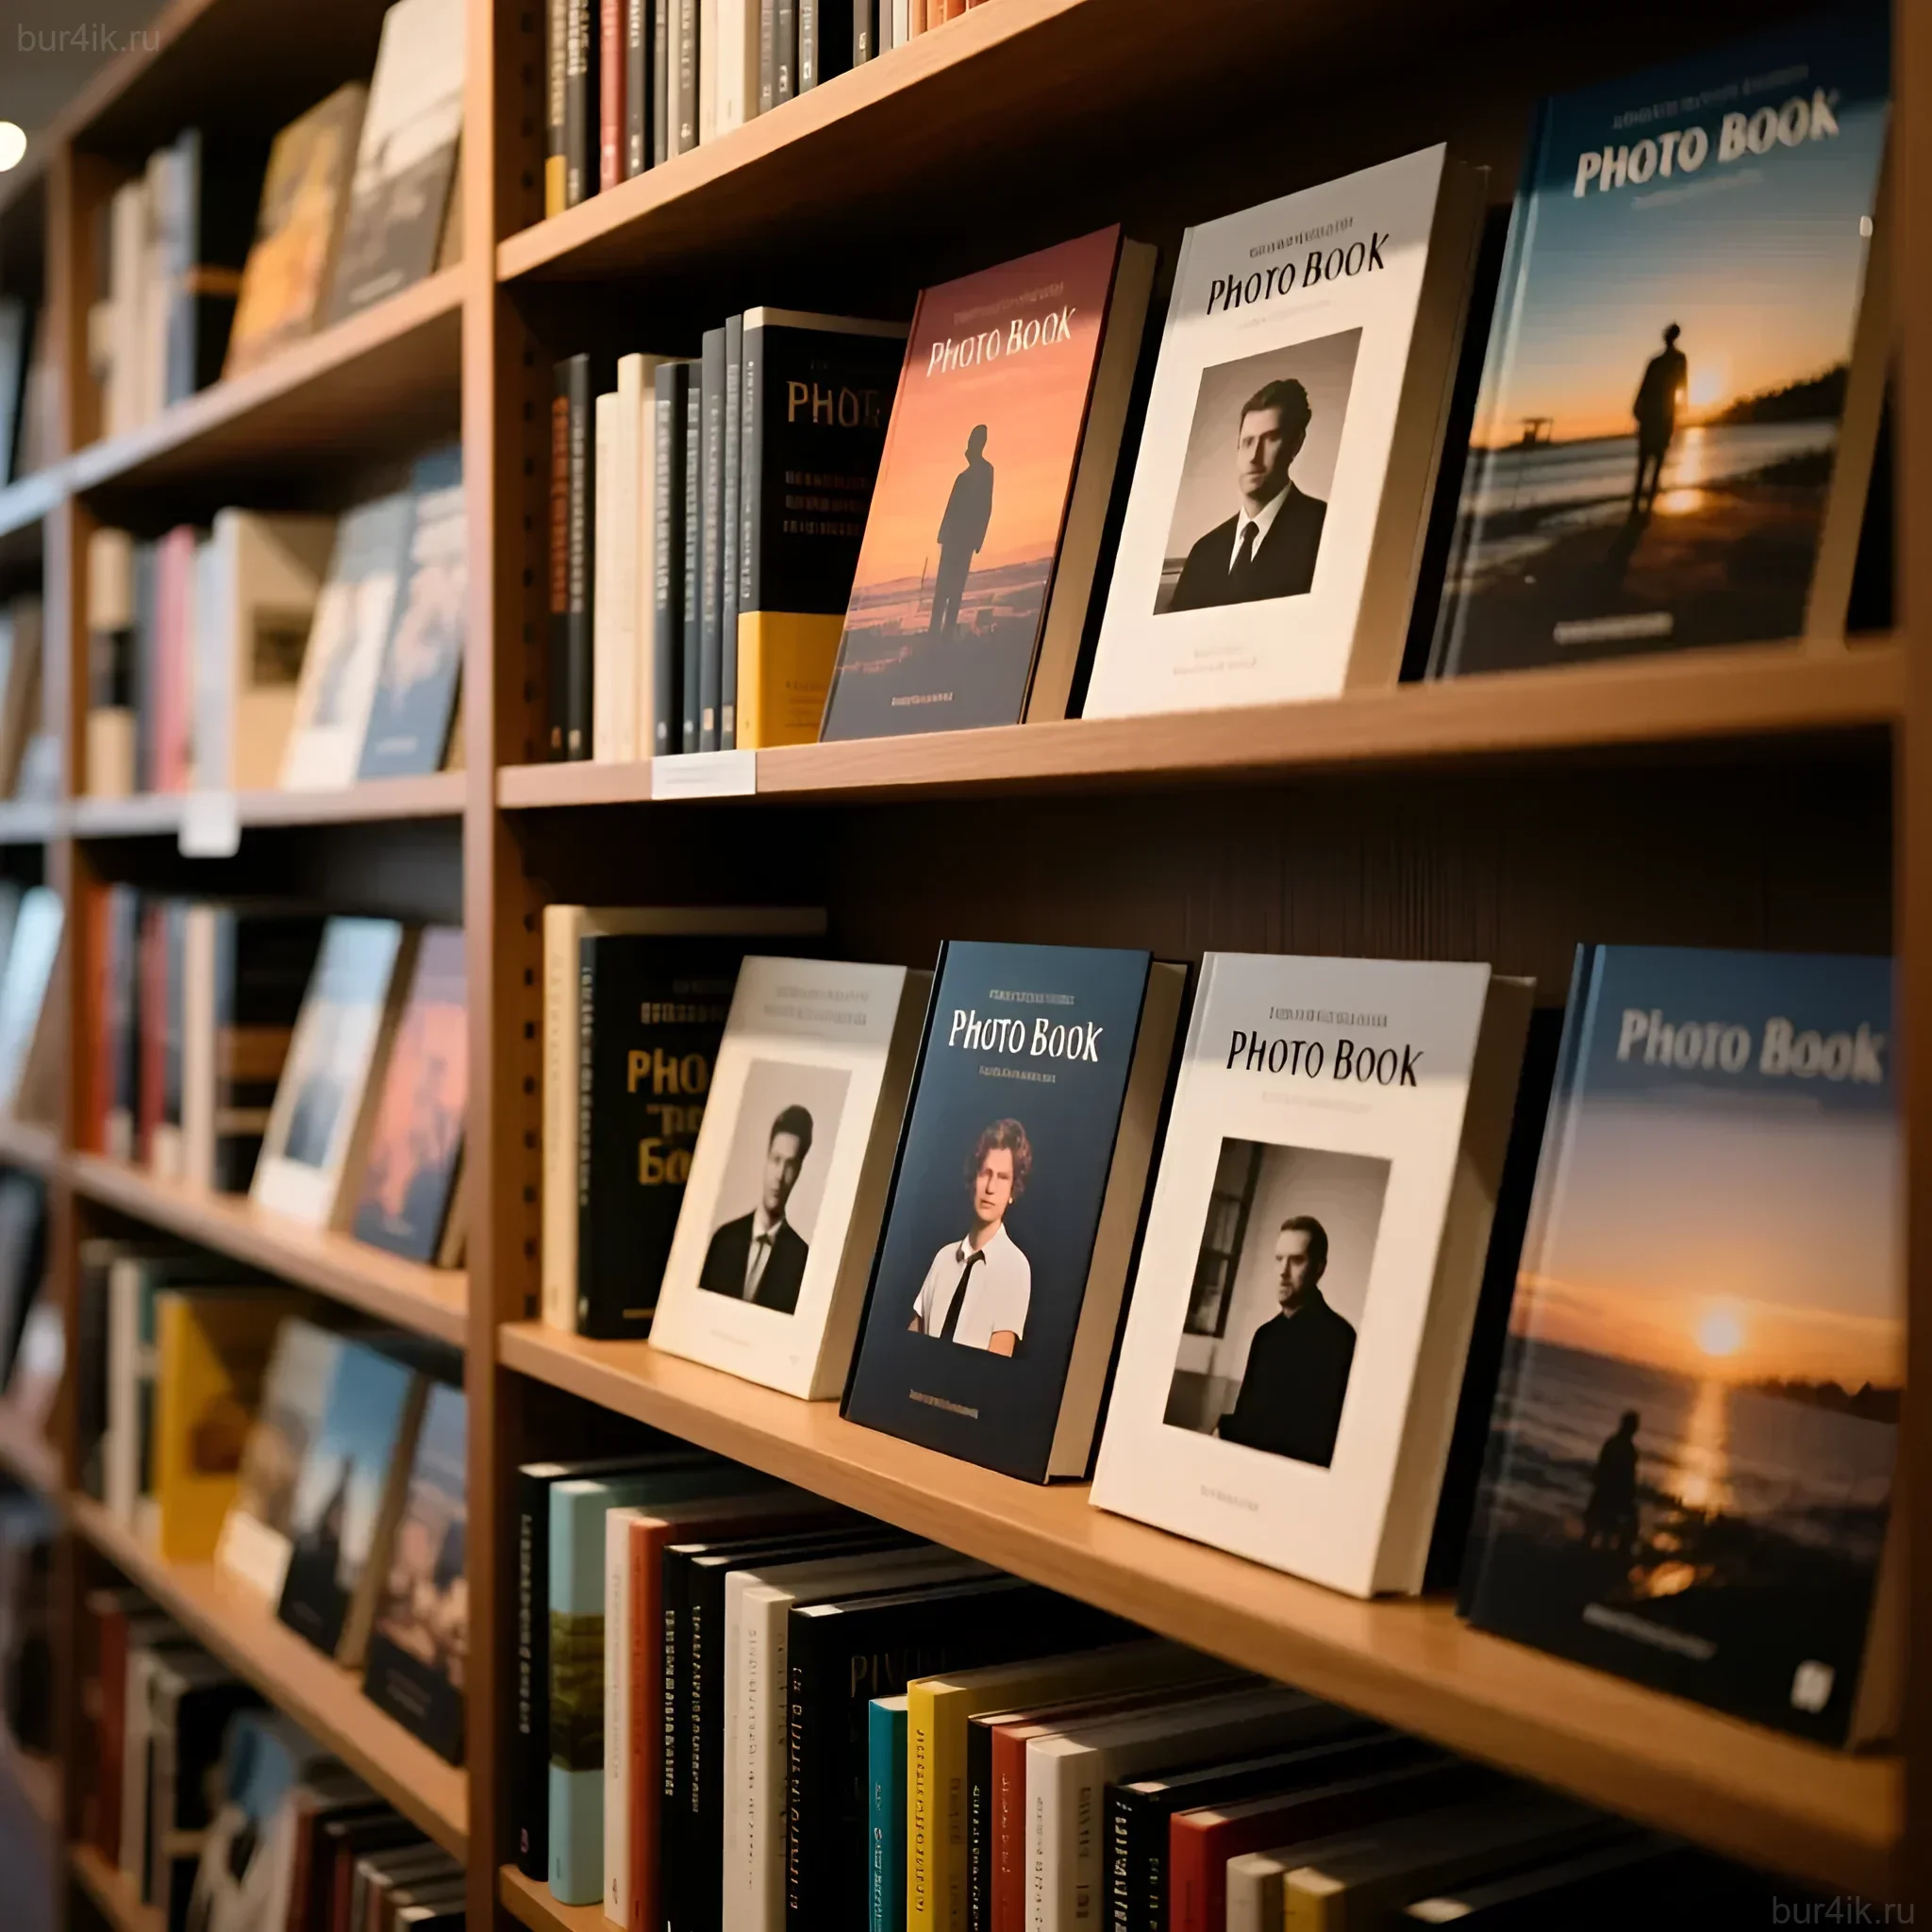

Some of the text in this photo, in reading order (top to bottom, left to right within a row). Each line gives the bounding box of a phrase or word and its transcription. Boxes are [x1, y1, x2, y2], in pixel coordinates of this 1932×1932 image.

[1573, 125, 1708, 198] PHOTO
[1718, 85, 1840, 163] BOOK
[1302, 231, 1390, 288] BOOK
[1006, 305, 1076, 356] BOOK
[1030, 1018, 1104, 1062] BOOK
[1333, 1040, 1424, 1087] BOOK
